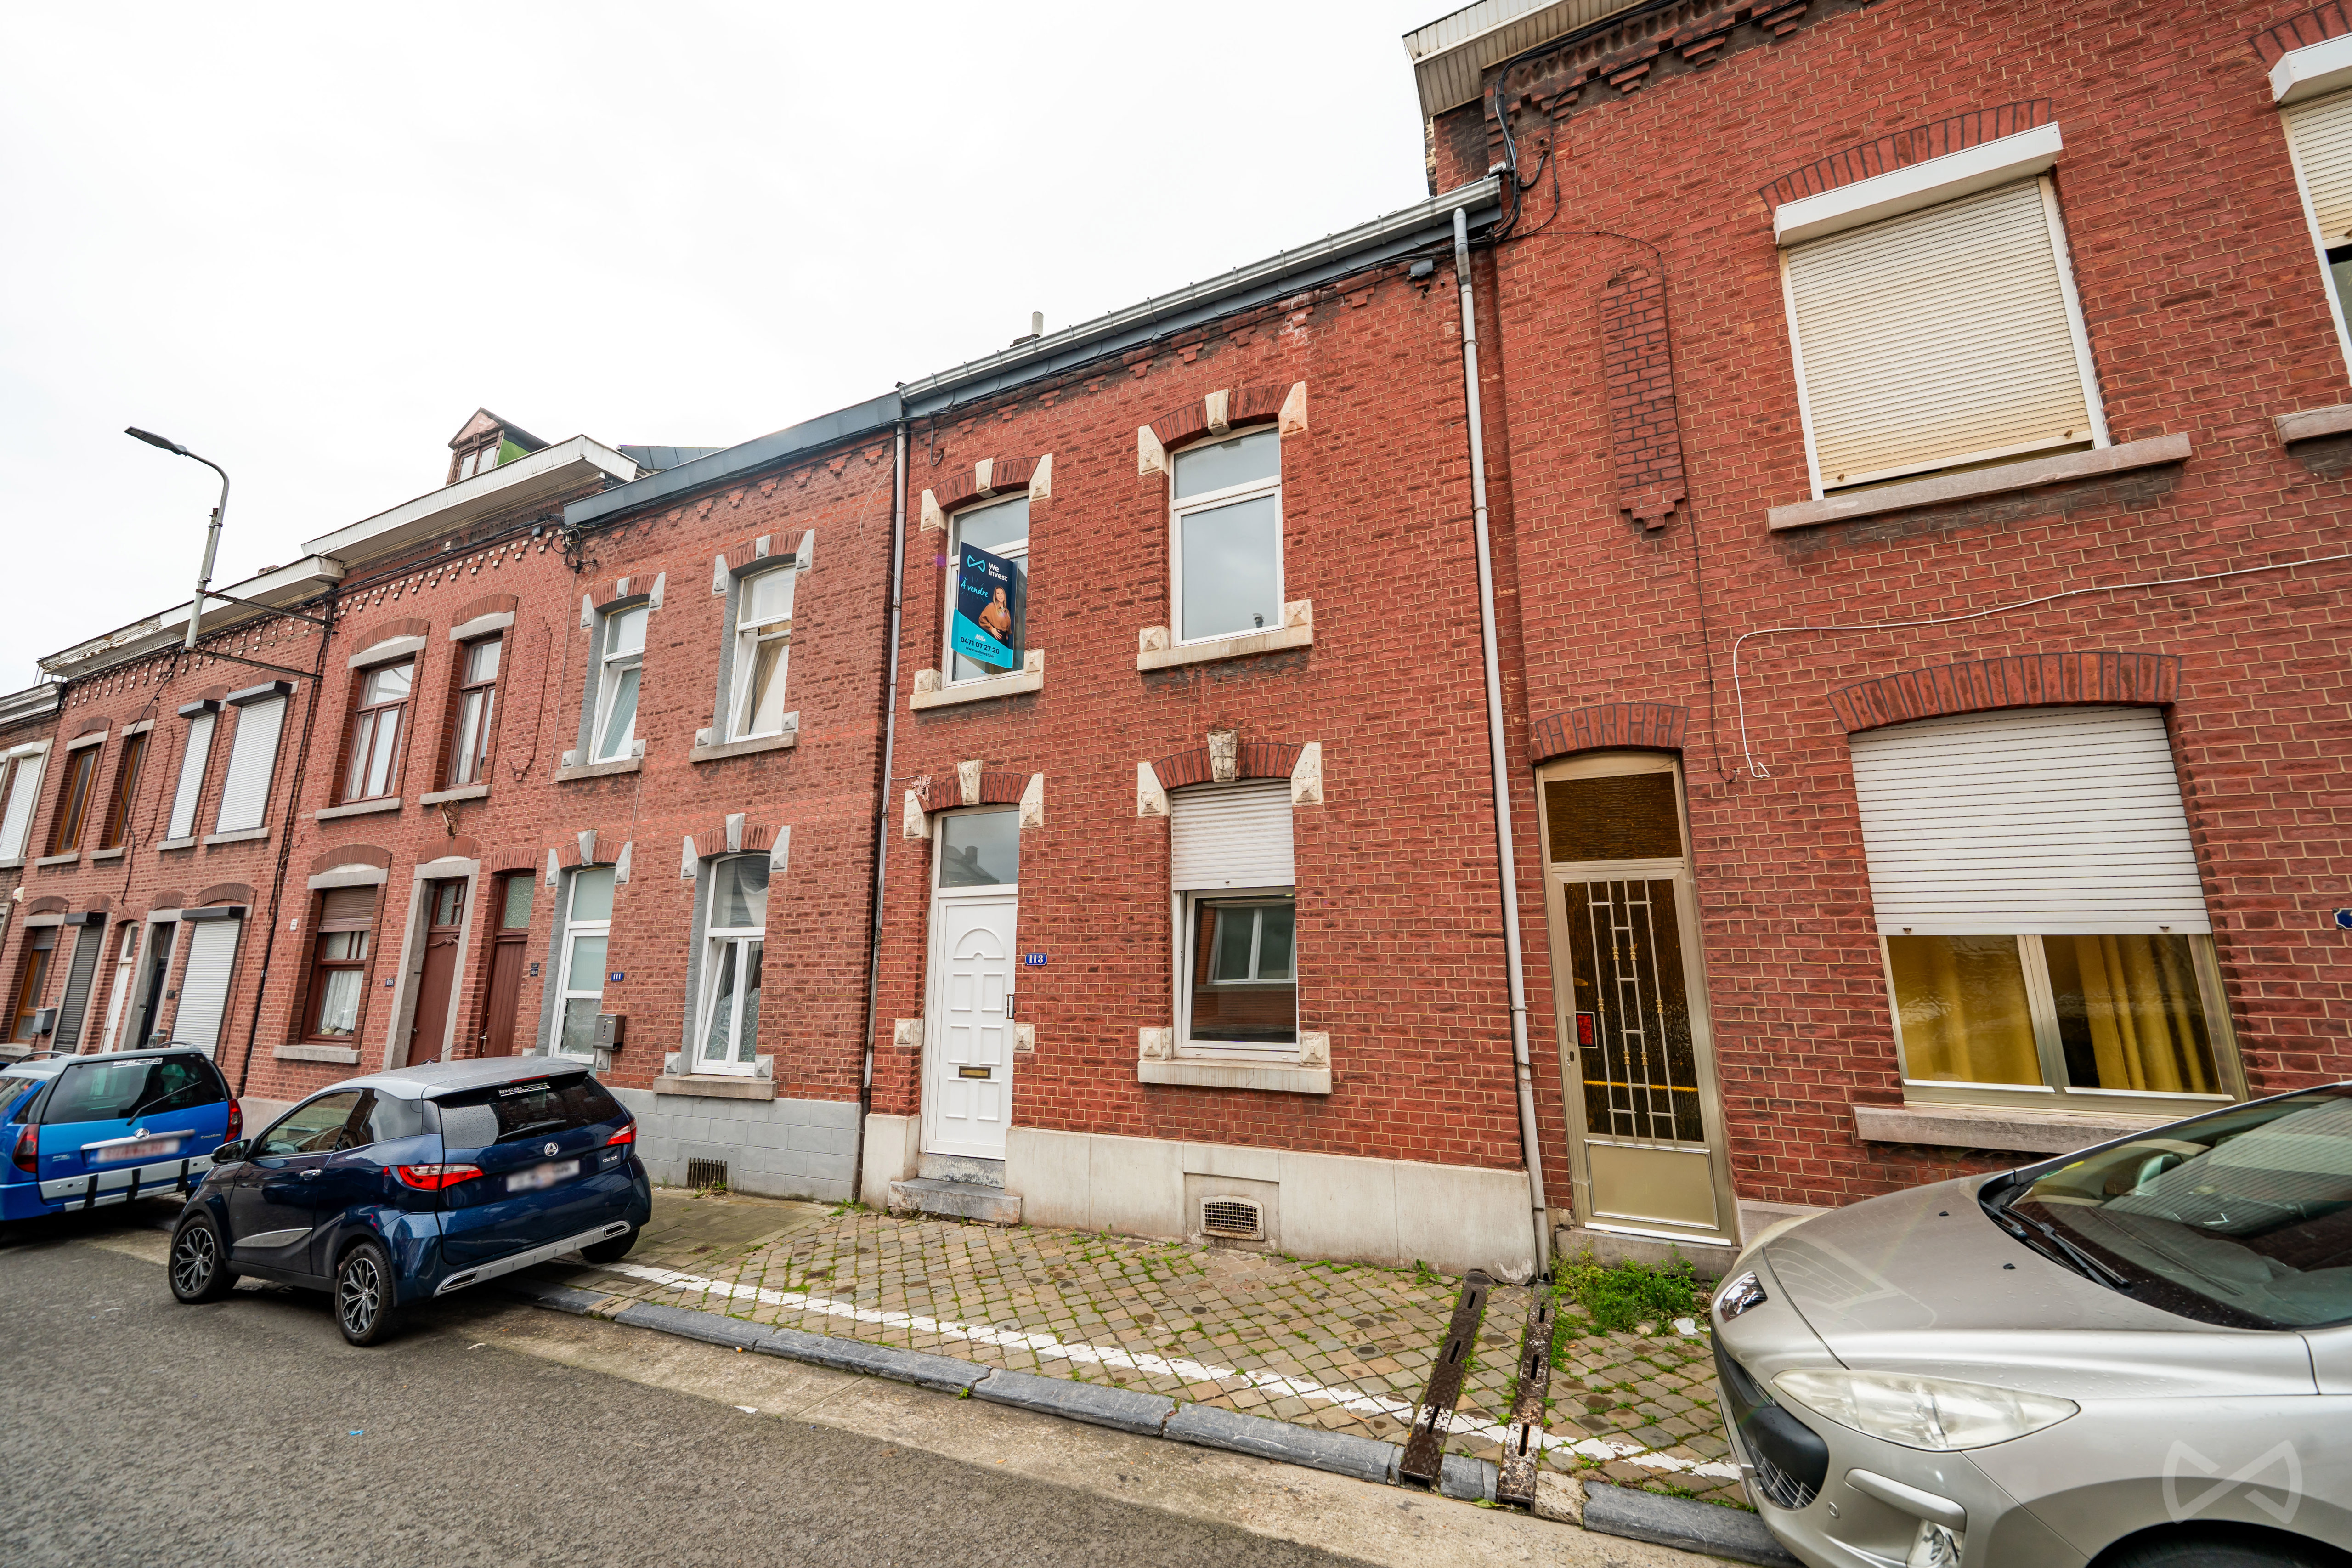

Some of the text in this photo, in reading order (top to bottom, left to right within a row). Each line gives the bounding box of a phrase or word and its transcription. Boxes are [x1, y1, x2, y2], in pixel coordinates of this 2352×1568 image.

[989, 562, 999, 572] We
[989, 569, 1008, 582] Invest
[961, 577, 988, 597] À vendre
[961, 637, 974, 646] 0471
[966, 646, 994, 658] www.weinvest.be
[1029, 954, 1043, 963] 113
